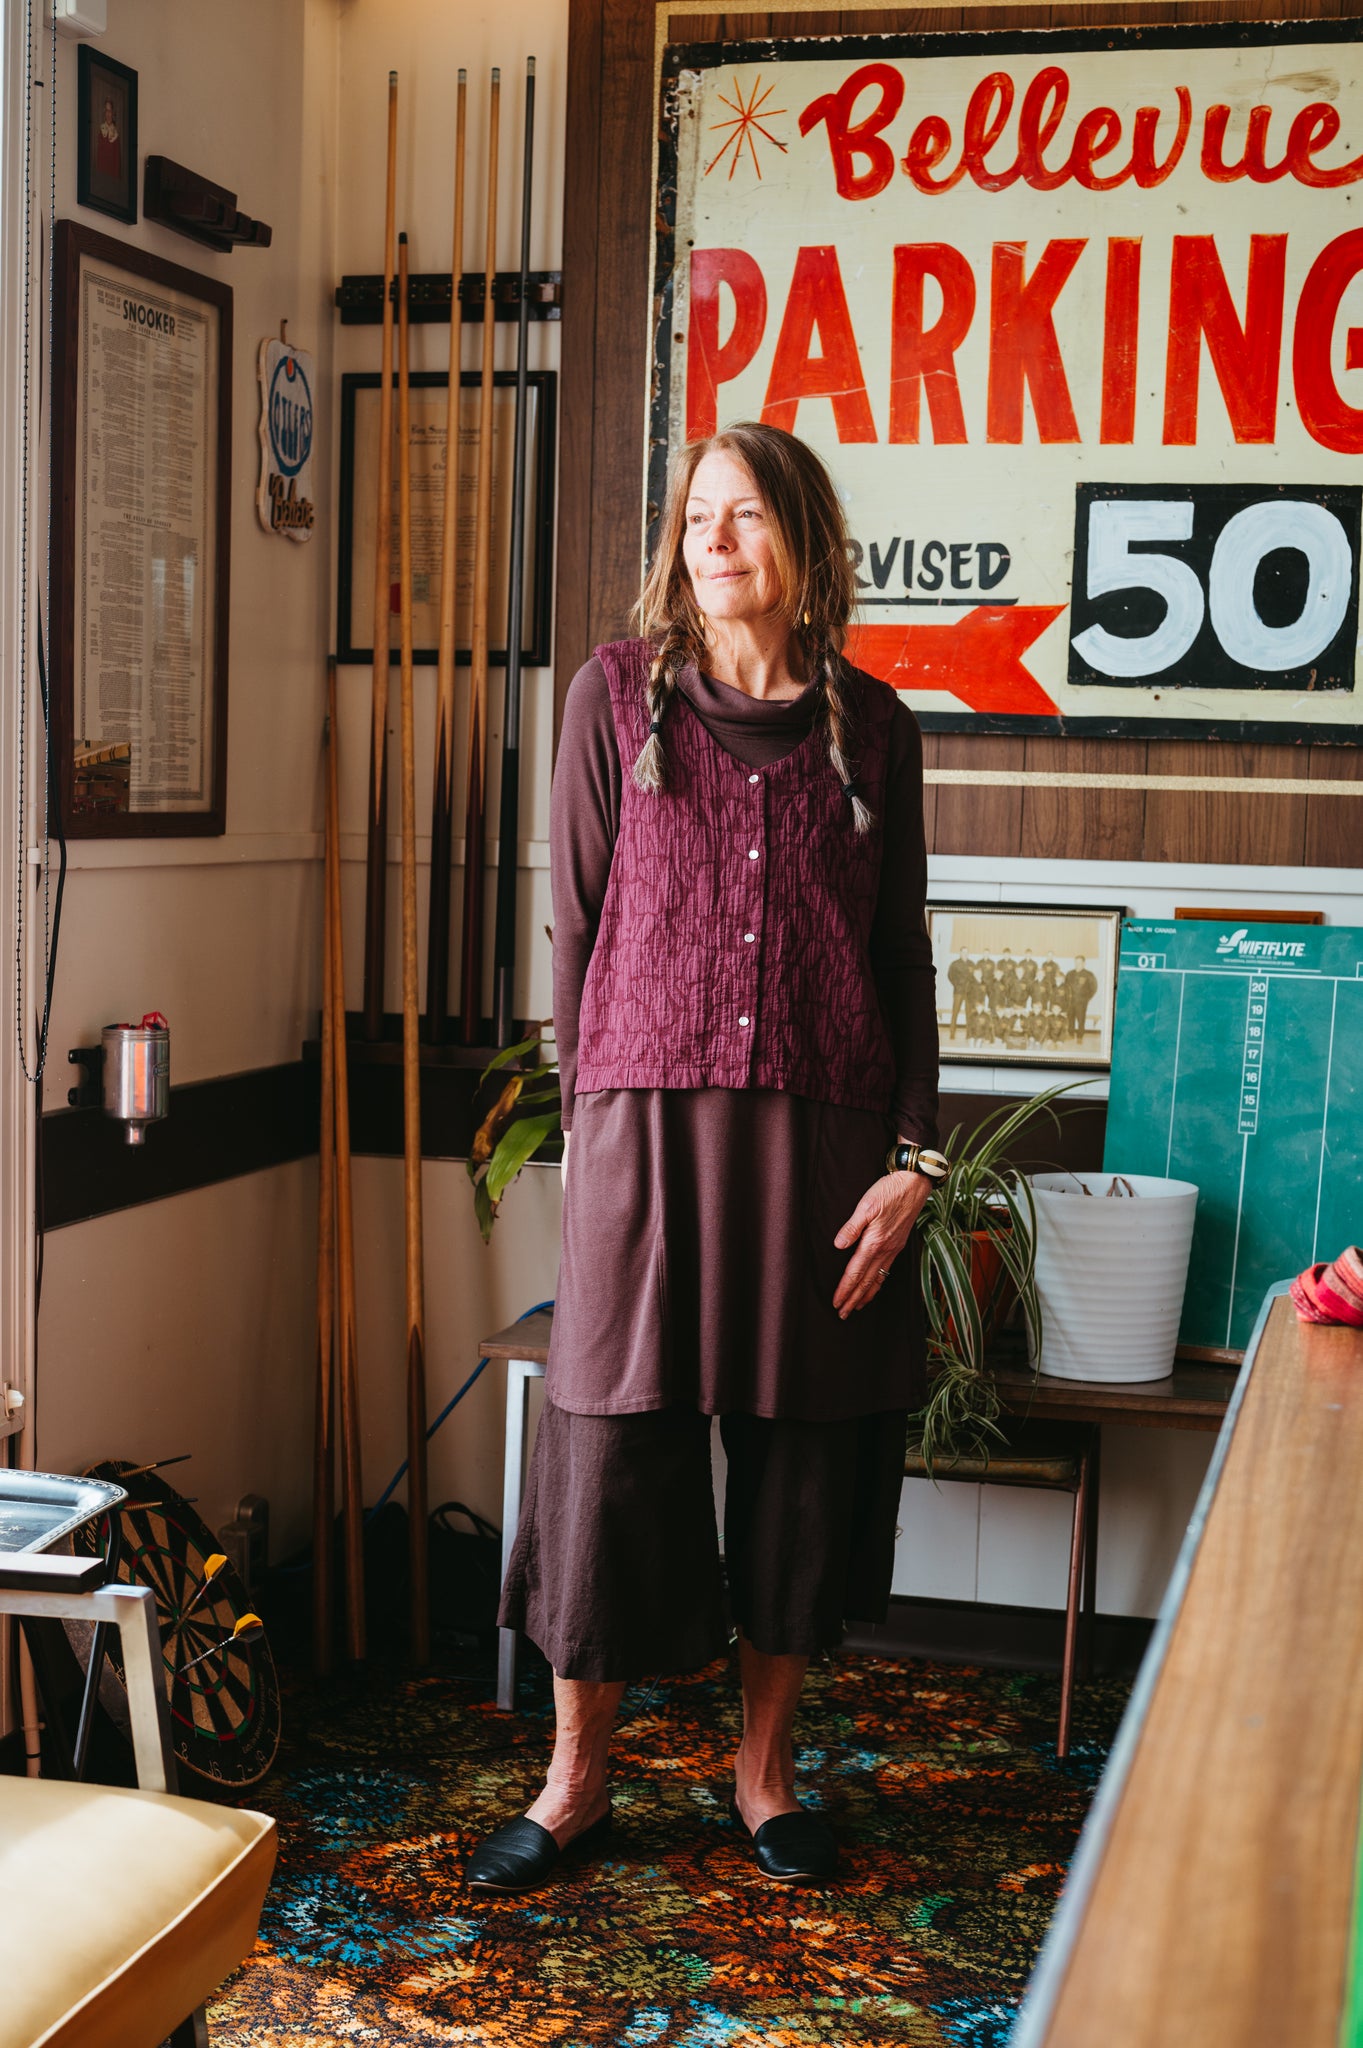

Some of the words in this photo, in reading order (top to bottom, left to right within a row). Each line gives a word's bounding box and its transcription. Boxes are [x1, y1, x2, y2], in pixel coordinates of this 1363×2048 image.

[798, 62, 1363, 200] Bellevue
[123, 299, 176, 336] SNOOKER
[685, 227, 1363, 454] PARKING
[1071, 500, 1353, 678] 50
[1137, 954, 1157, 969] 01
[1251, 982, 1266, 993] 20
[1251, 1004, 1263, 1015] 19
[1249, 1026, 1261, 1037] 18
[1247, 1049, 1259, 1060] 17
[1245, 1072, 1257, 1083] 16
[1243, 1094, 1255, 1105] 15
[1240, 1120, 1255, 1128] BULL
